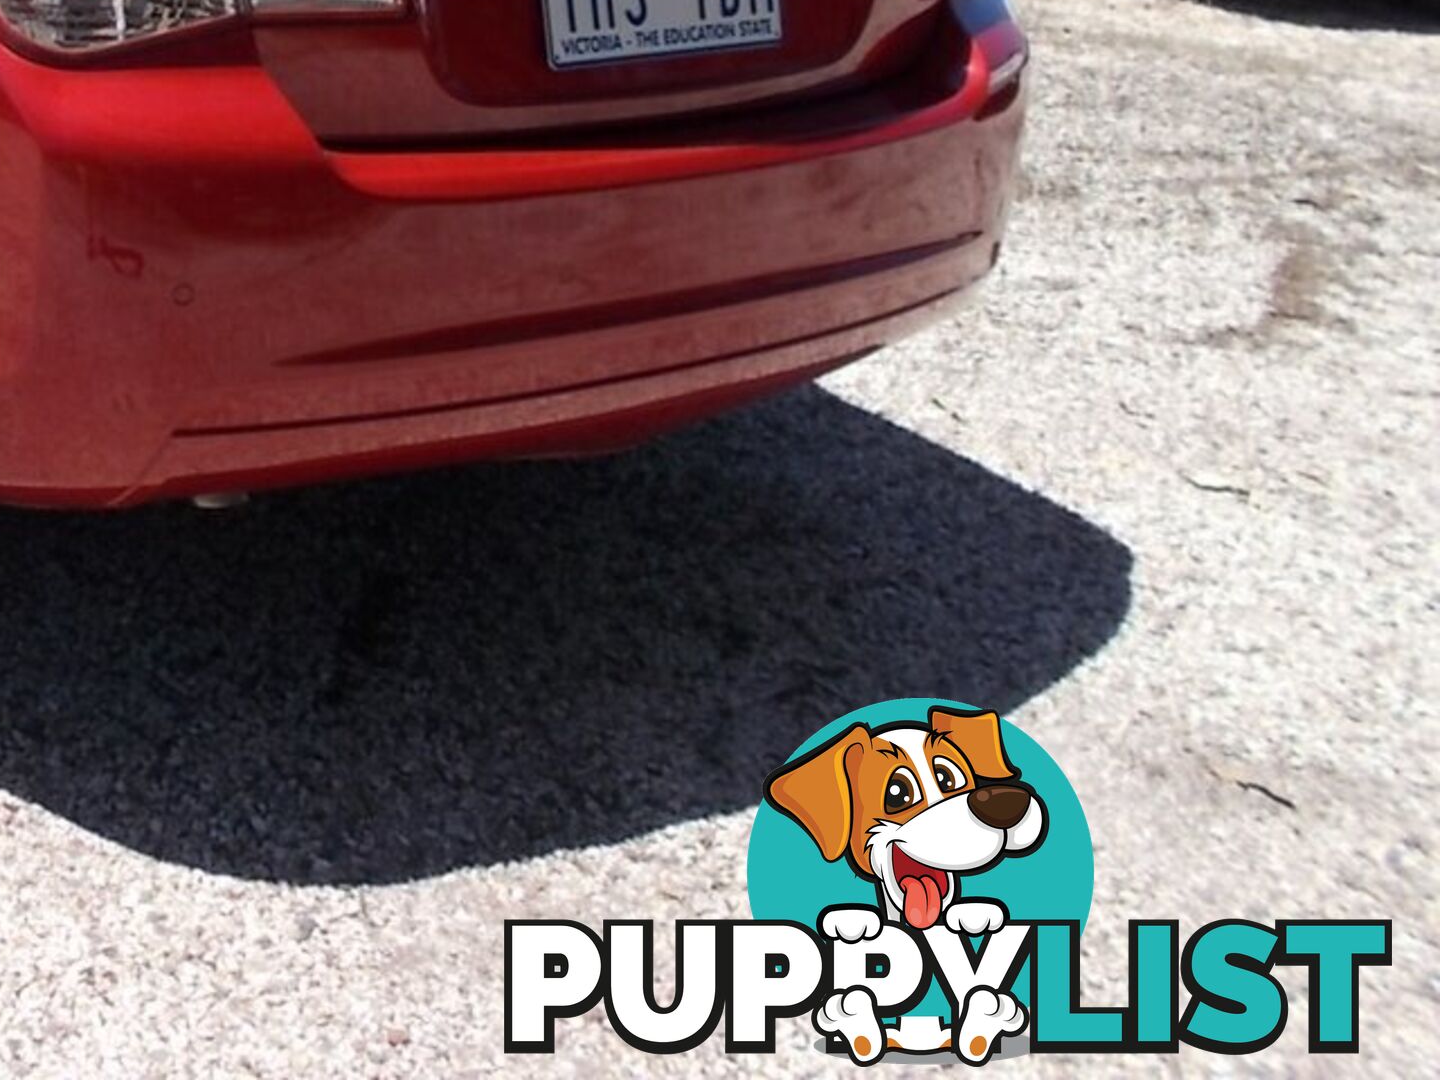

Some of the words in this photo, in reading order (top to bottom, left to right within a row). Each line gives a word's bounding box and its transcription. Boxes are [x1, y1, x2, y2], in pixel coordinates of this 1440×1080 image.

[561, 34, 623, 55] VICTORIA
[634, 30, 659, 48] THE
[662, 23, 736, 46] EDUCATION
[738, 18, 772, 37] STATE
